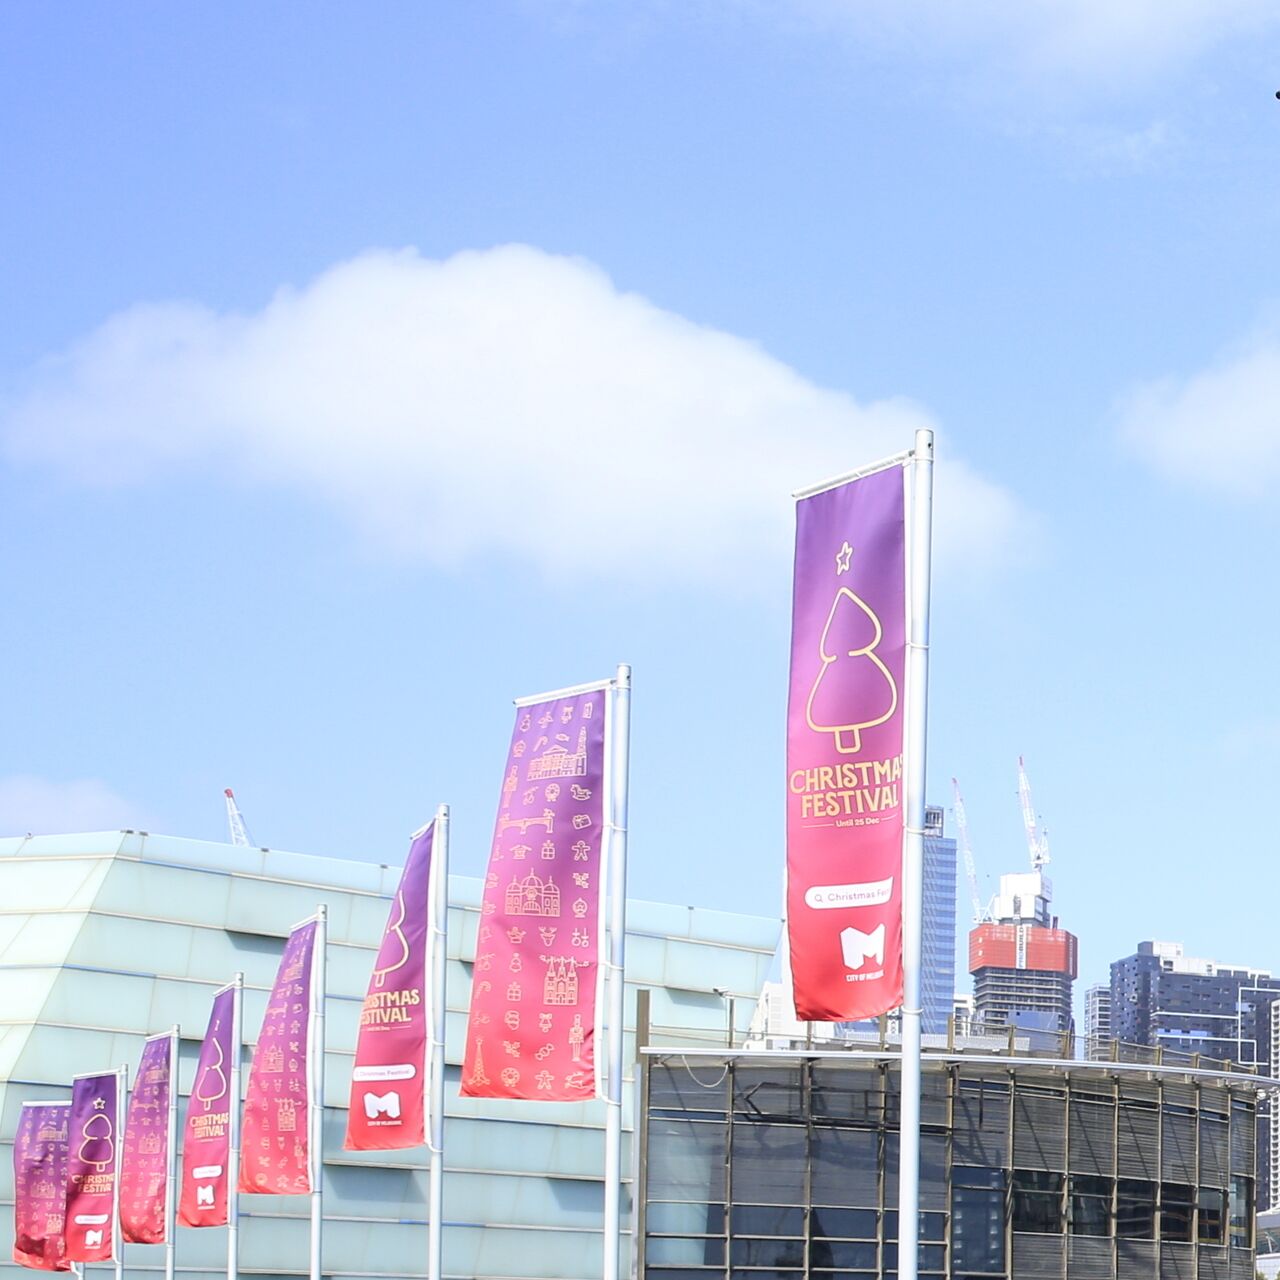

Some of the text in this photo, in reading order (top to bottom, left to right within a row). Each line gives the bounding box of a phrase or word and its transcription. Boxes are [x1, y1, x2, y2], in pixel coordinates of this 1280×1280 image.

[790, 754, 902, 793] CHRISTMA
[801, 784, 898, 818] FESTIVAL
[828, 891, 875, 902] Christmas
